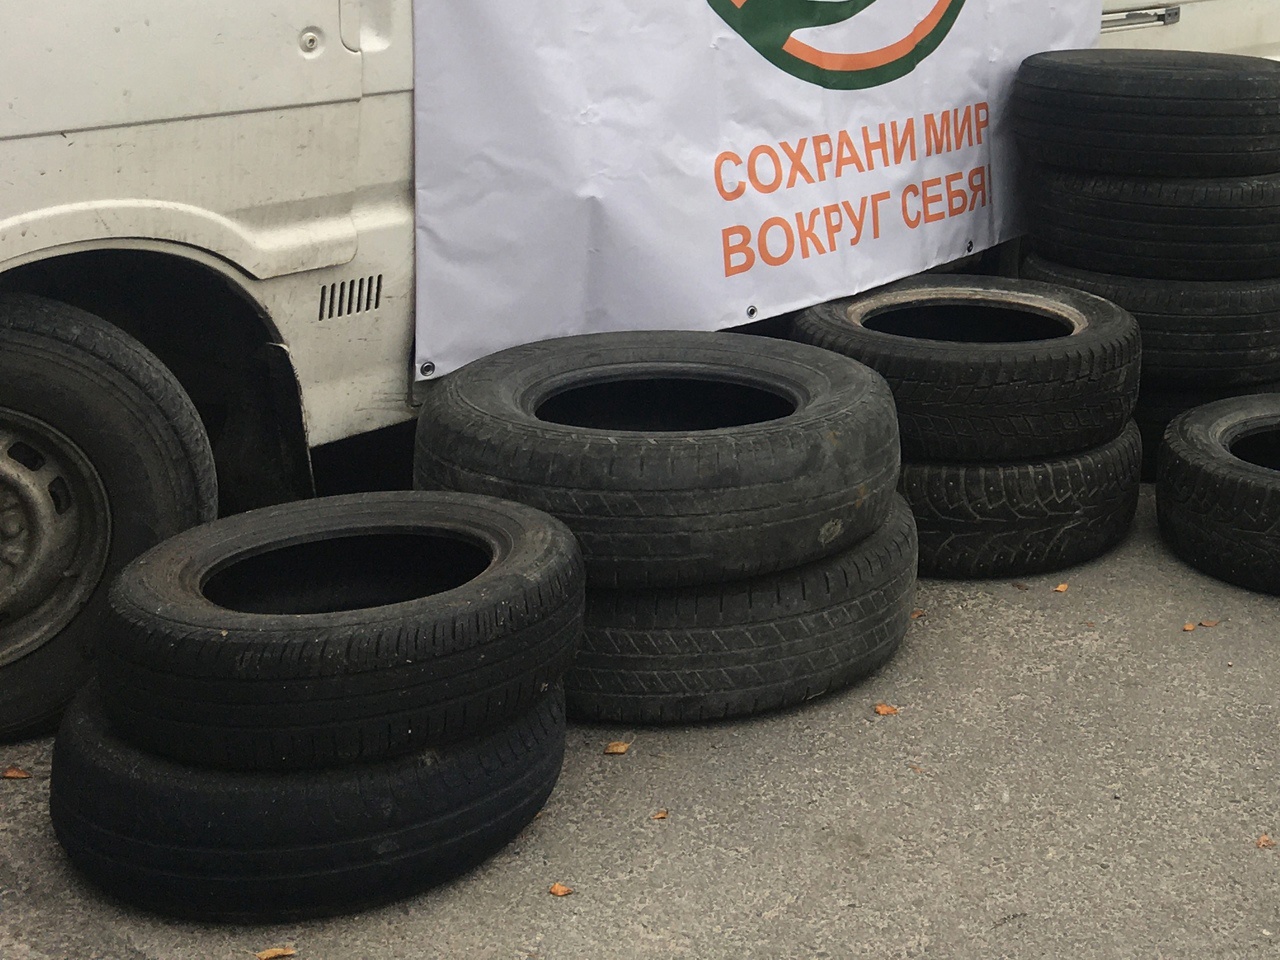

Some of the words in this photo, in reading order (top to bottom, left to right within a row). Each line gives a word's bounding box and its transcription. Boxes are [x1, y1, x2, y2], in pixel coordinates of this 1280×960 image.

[714, 117, 916, 202] СОХРАНИ
[923, 101, 989, 157] МИР
[721, 191, 891, 278] ВОКРУГ
[901, 162, 993, 229] СЕБЯ!
